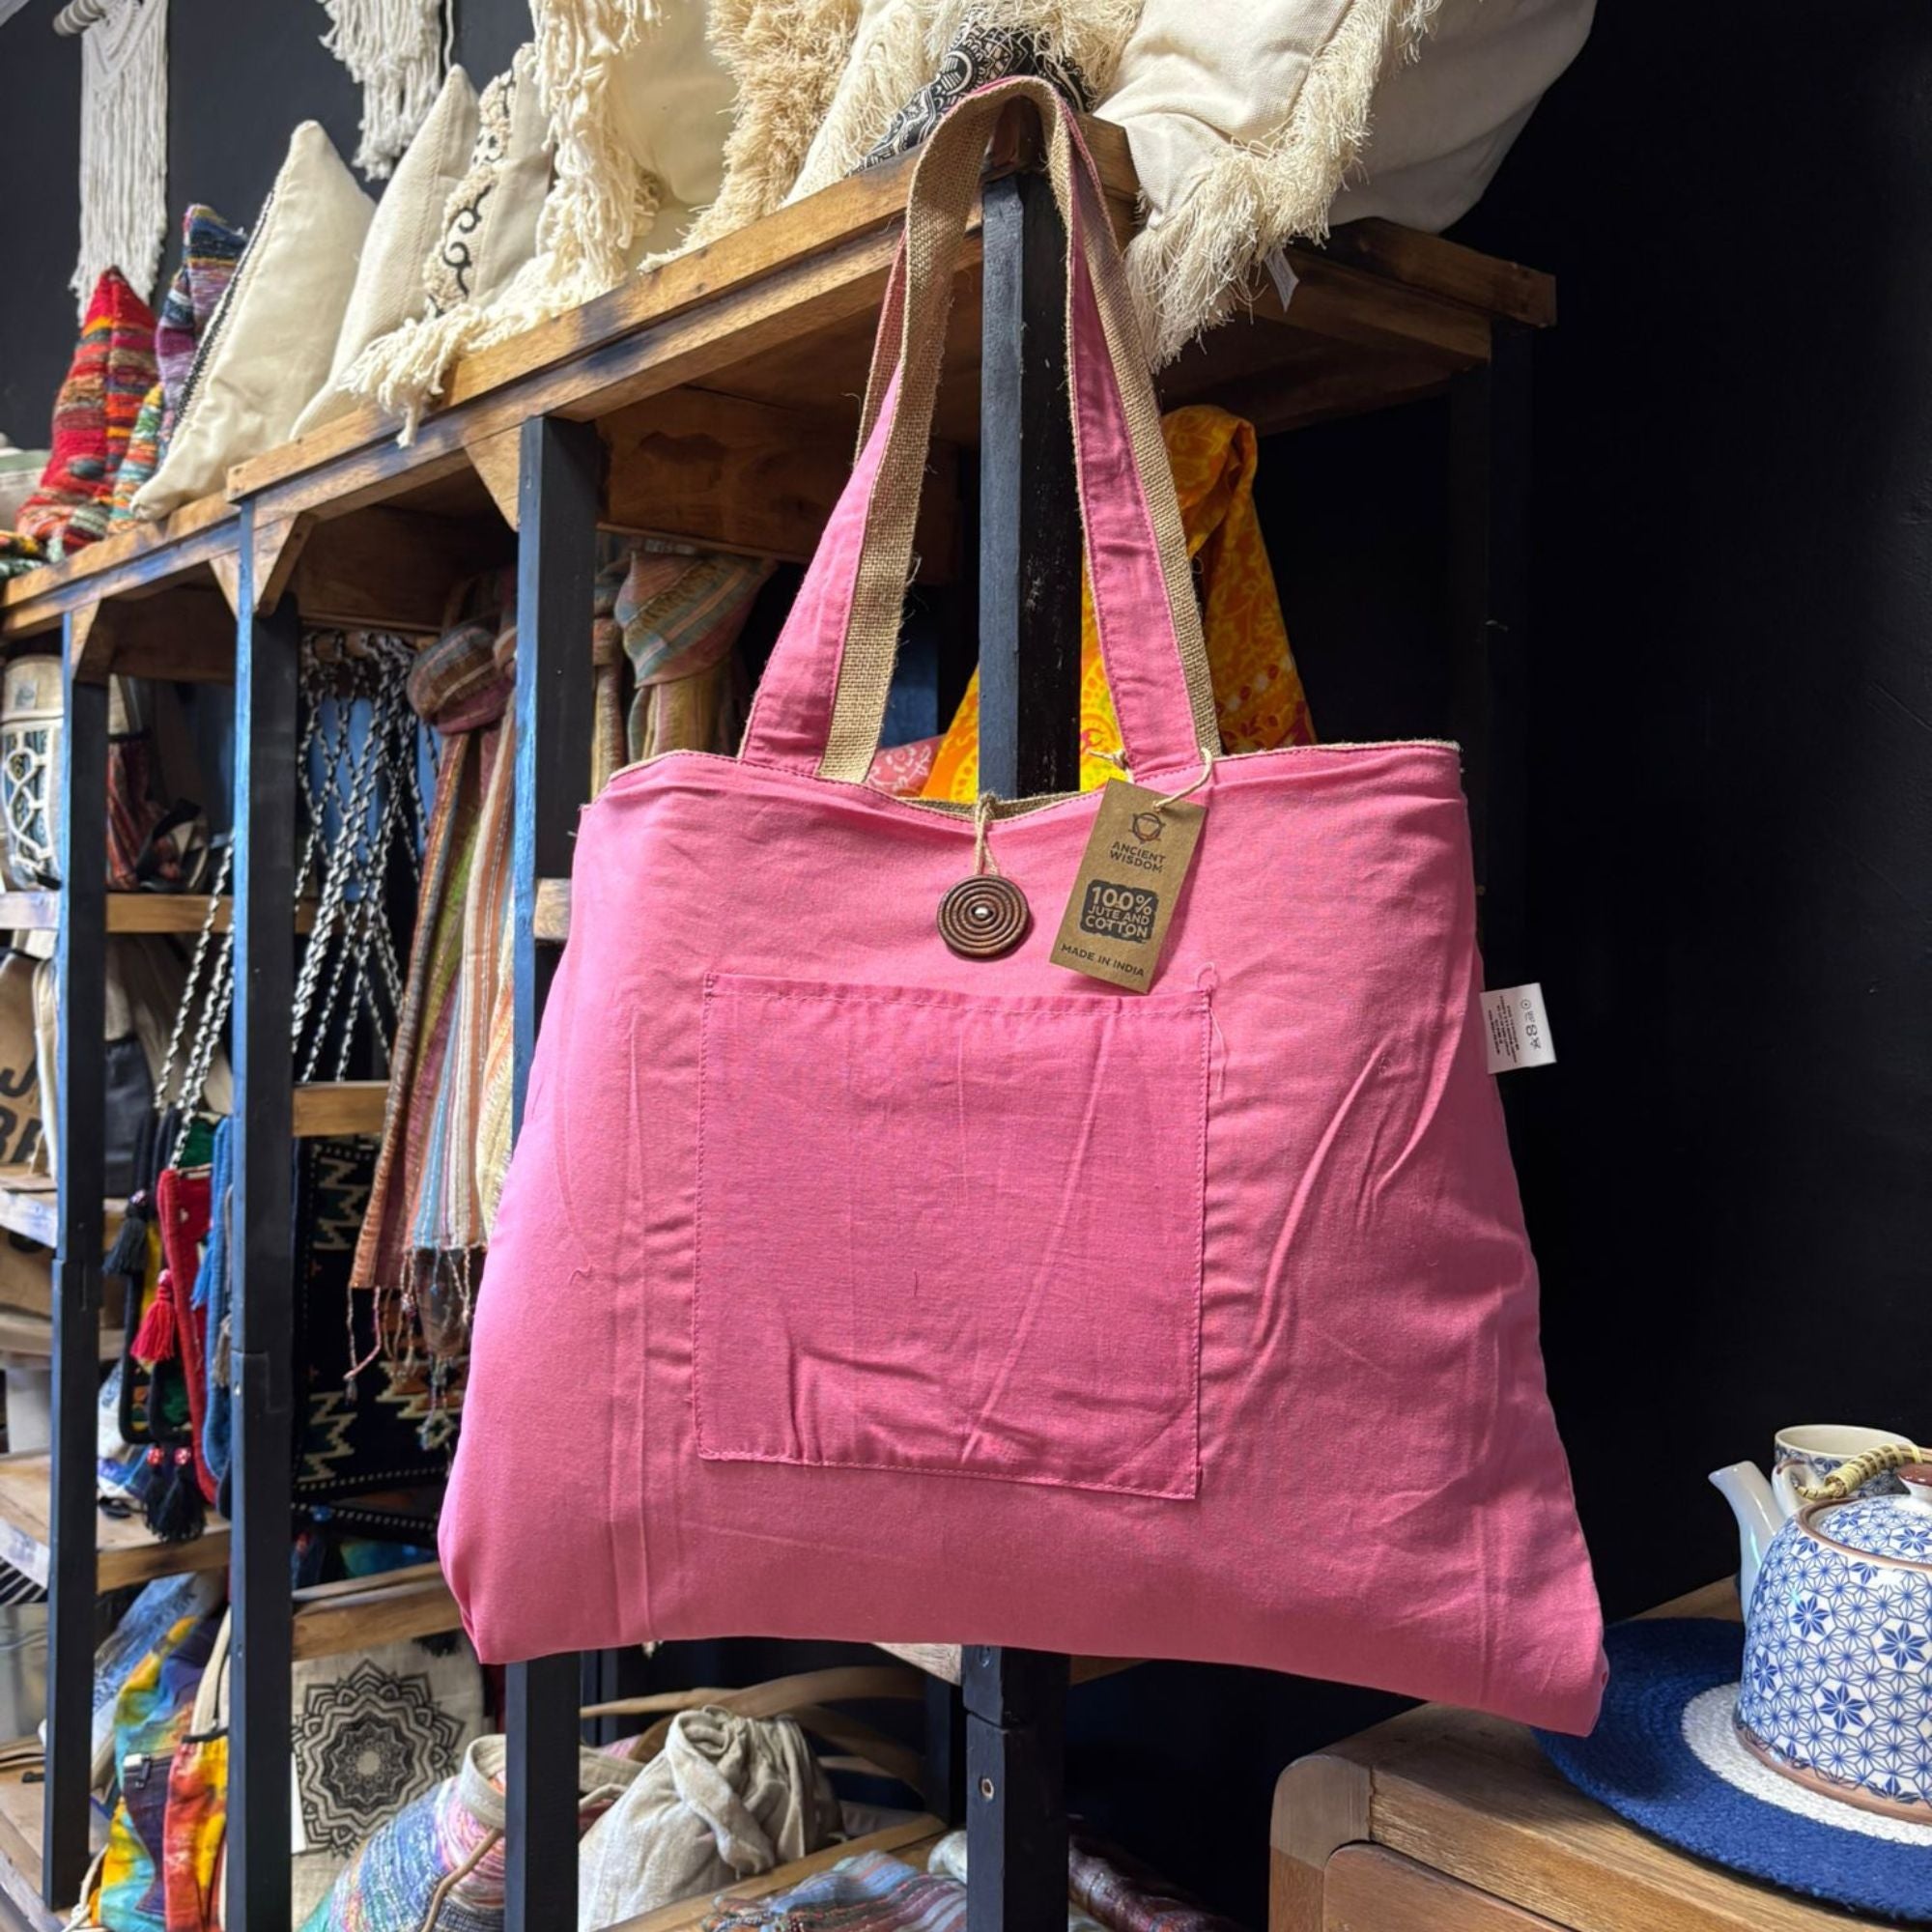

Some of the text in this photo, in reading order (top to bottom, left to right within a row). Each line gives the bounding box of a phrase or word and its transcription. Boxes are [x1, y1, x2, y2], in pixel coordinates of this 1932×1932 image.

[1110, 850, 1163, 873] WISDOM
[1112, 841, 1166, 864] ANCIENT
[1091, 886, 1152, 916] 100%
[1088, 905, 1150, 925] JUTE AND
[1086, 916, 1149, 938] COTTON
[1061, 944, 1145, 977] MADE IN INDIA
